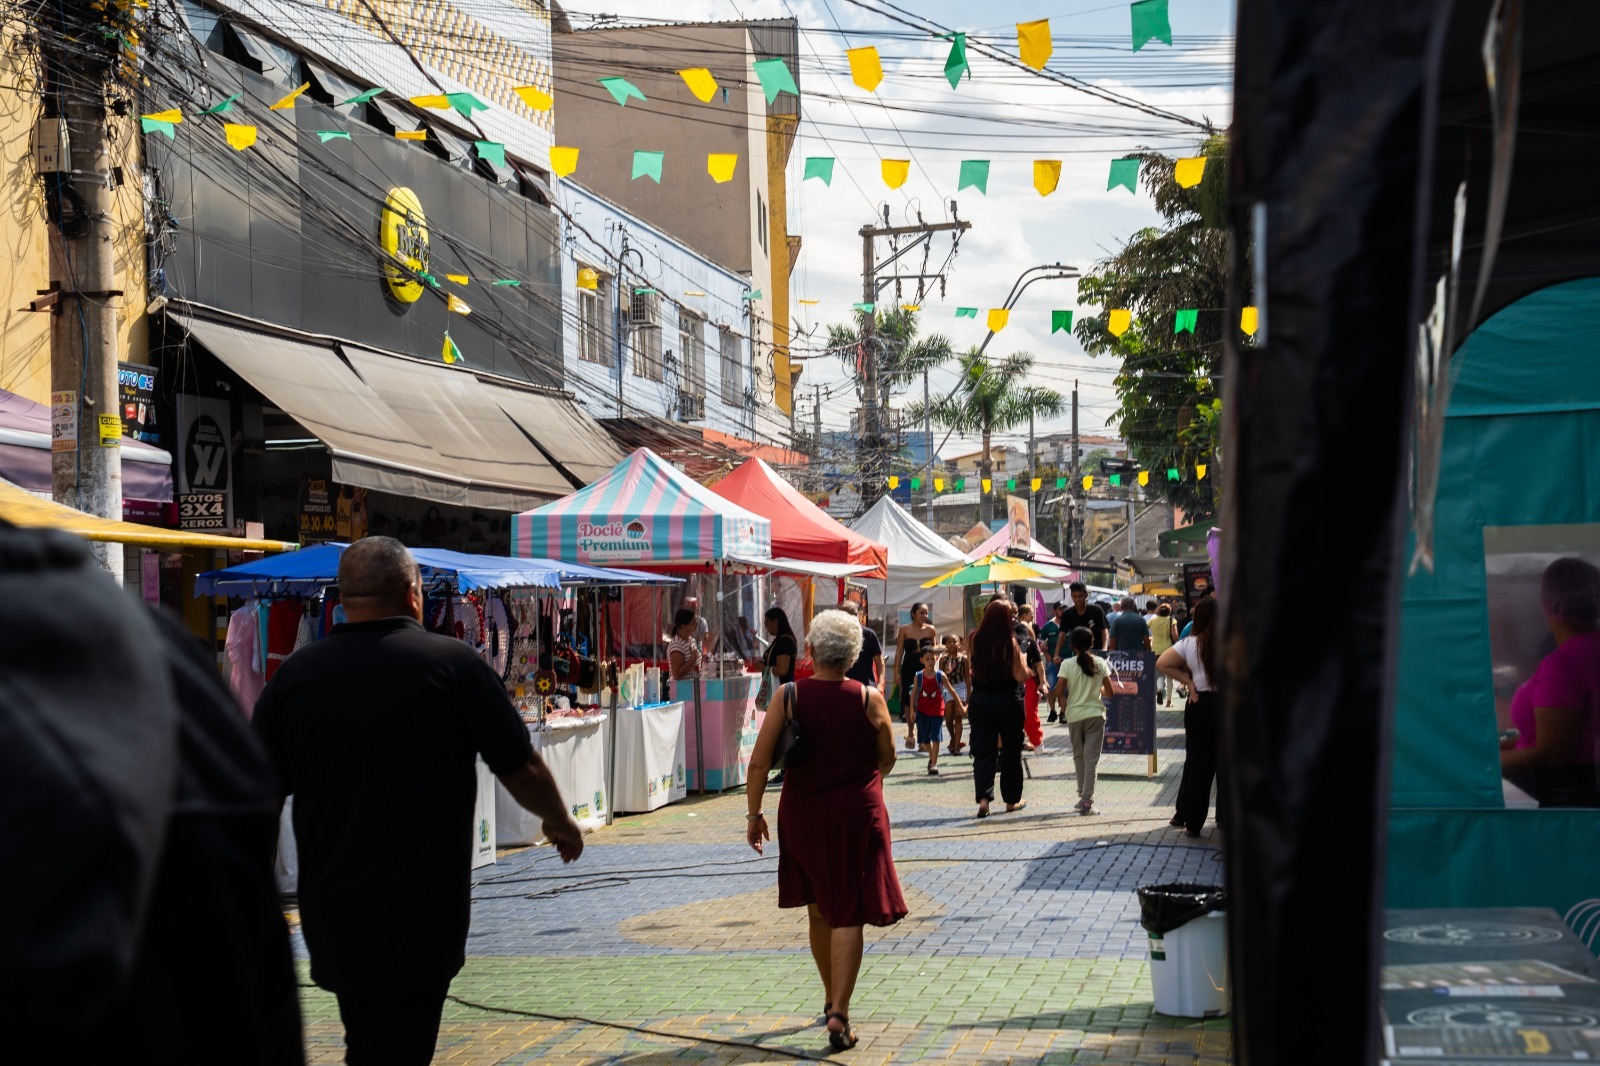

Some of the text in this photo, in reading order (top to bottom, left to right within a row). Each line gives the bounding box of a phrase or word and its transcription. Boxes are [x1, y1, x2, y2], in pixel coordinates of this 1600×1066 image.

[180, 495, 223, 503] FOTOS
[180, 503, 224, 516] 3X4
[180, 519, 224, 528] XEROX
[579, 538, 650, 551] Premium
